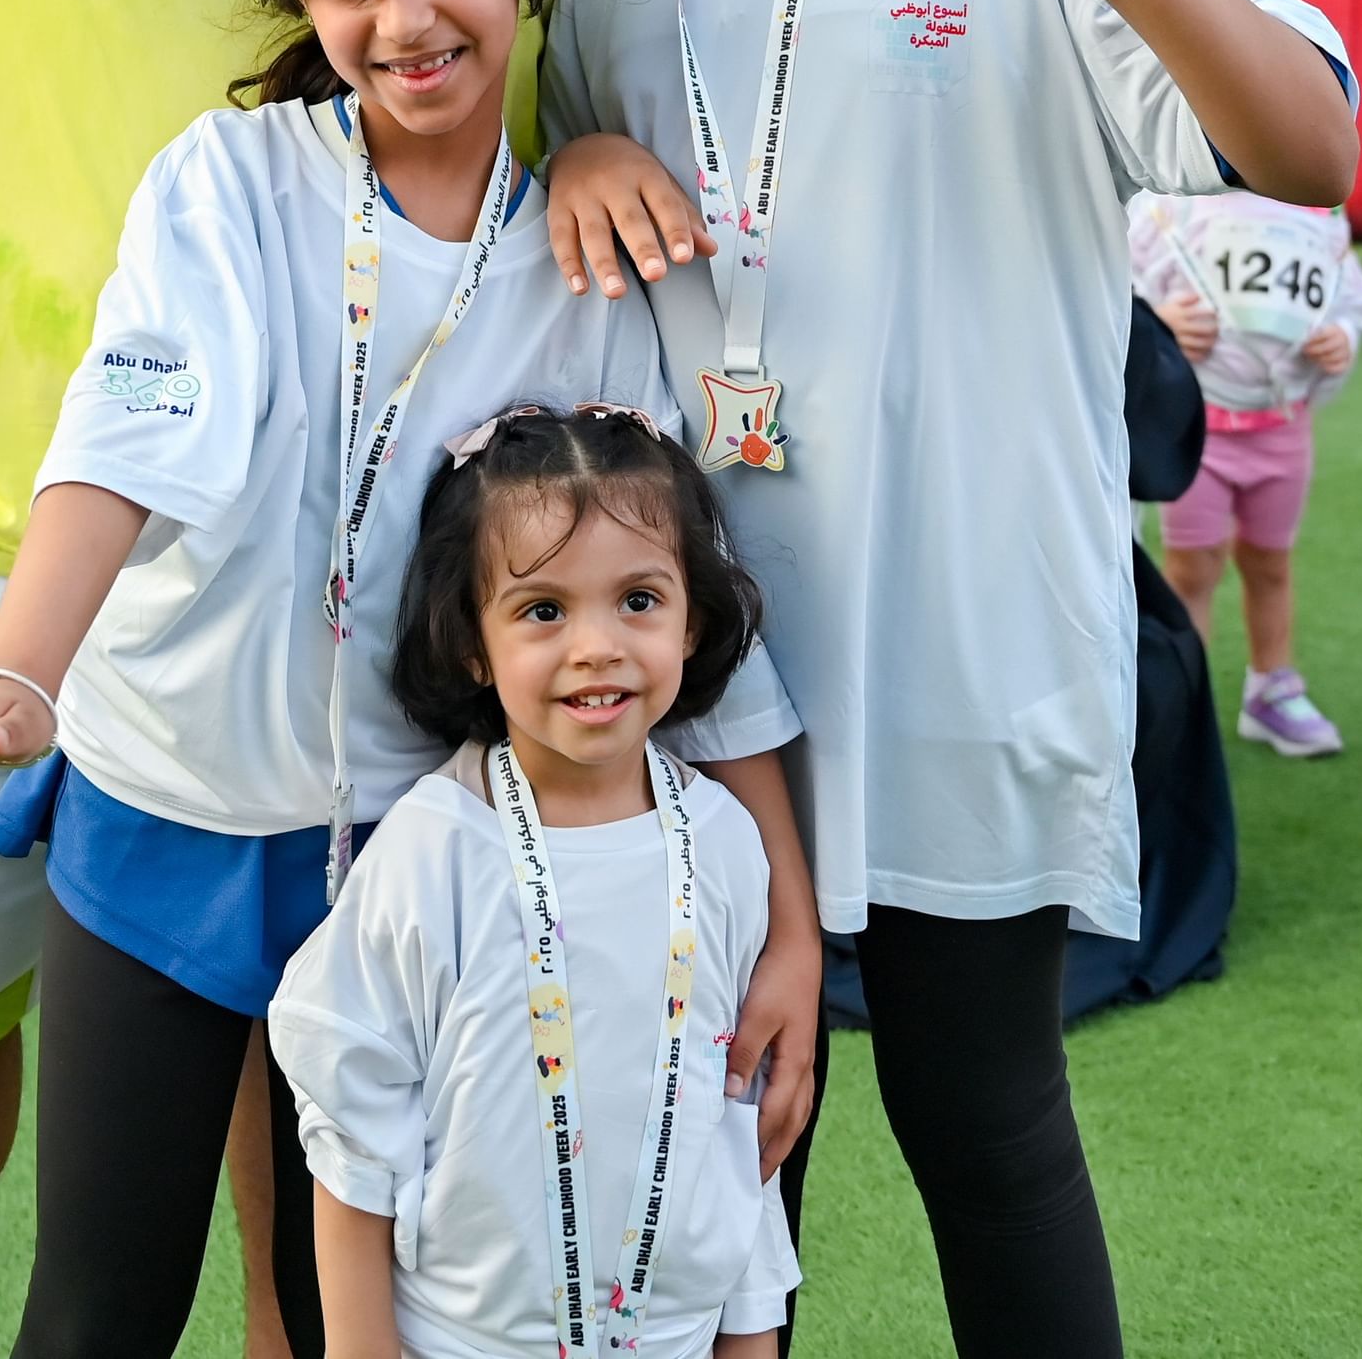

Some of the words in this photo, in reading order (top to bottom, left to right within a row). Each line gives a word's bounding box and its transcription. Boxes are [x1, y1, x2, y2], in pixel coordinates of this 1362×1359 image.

[890, 1, 931, 20] أبوظبي
[933, 3, 967, 19] أسبوع
[780, 20, 794, 51] WEEK
[910, 33, 949, 49] المبكرة
[925, 19, 966, 36] للطفولة
[692, 82, 706, 114] EARLY
[771, 54, 789, 115] CHILDHOOD
[698, 116, 715, 149] DHABI
[766, 118, 780, 154] EARLY
[707, 151, 720, 173] ABU
[761, 155, 775, 190] DHABI
[757, 192, 769, 215] ABU
[1215, 249, 1325, 309] 1246
[103, 353, 137, 368] Abu
[142, 357, 188, 374] Dhabi
[356, 341, 367, 371] 2025
[99, 369, 201, 406] 360
[353, 374, 364, 407] WEEK
[348, 467, 377, 533] CHILDHOOD
[367, 435, 388, 469] WEEK
[381, 404, 398, 433] 2025
[670, 1037, 682, 1069] 2025
[664, 1072, 678, 1107] WEEK
[552, 1094, 568, 1127] 2025
[555, 1129, 571, 1165] WEEK
[653, 1111, 674, 1183] CHILDHOOD
[559, 1167, 577, 1238] CHILDHOOD
[645, 1186, 664, 1226] EARLY
[564, 1240, 580, 1282] EARLY
[636, 1228, 656, 1267] DHABI
[630, 1267, 648, 1294] ABU
[567, 1281, 583, 1320] DHABI
[571, 1322, 585, 1347] ABU
